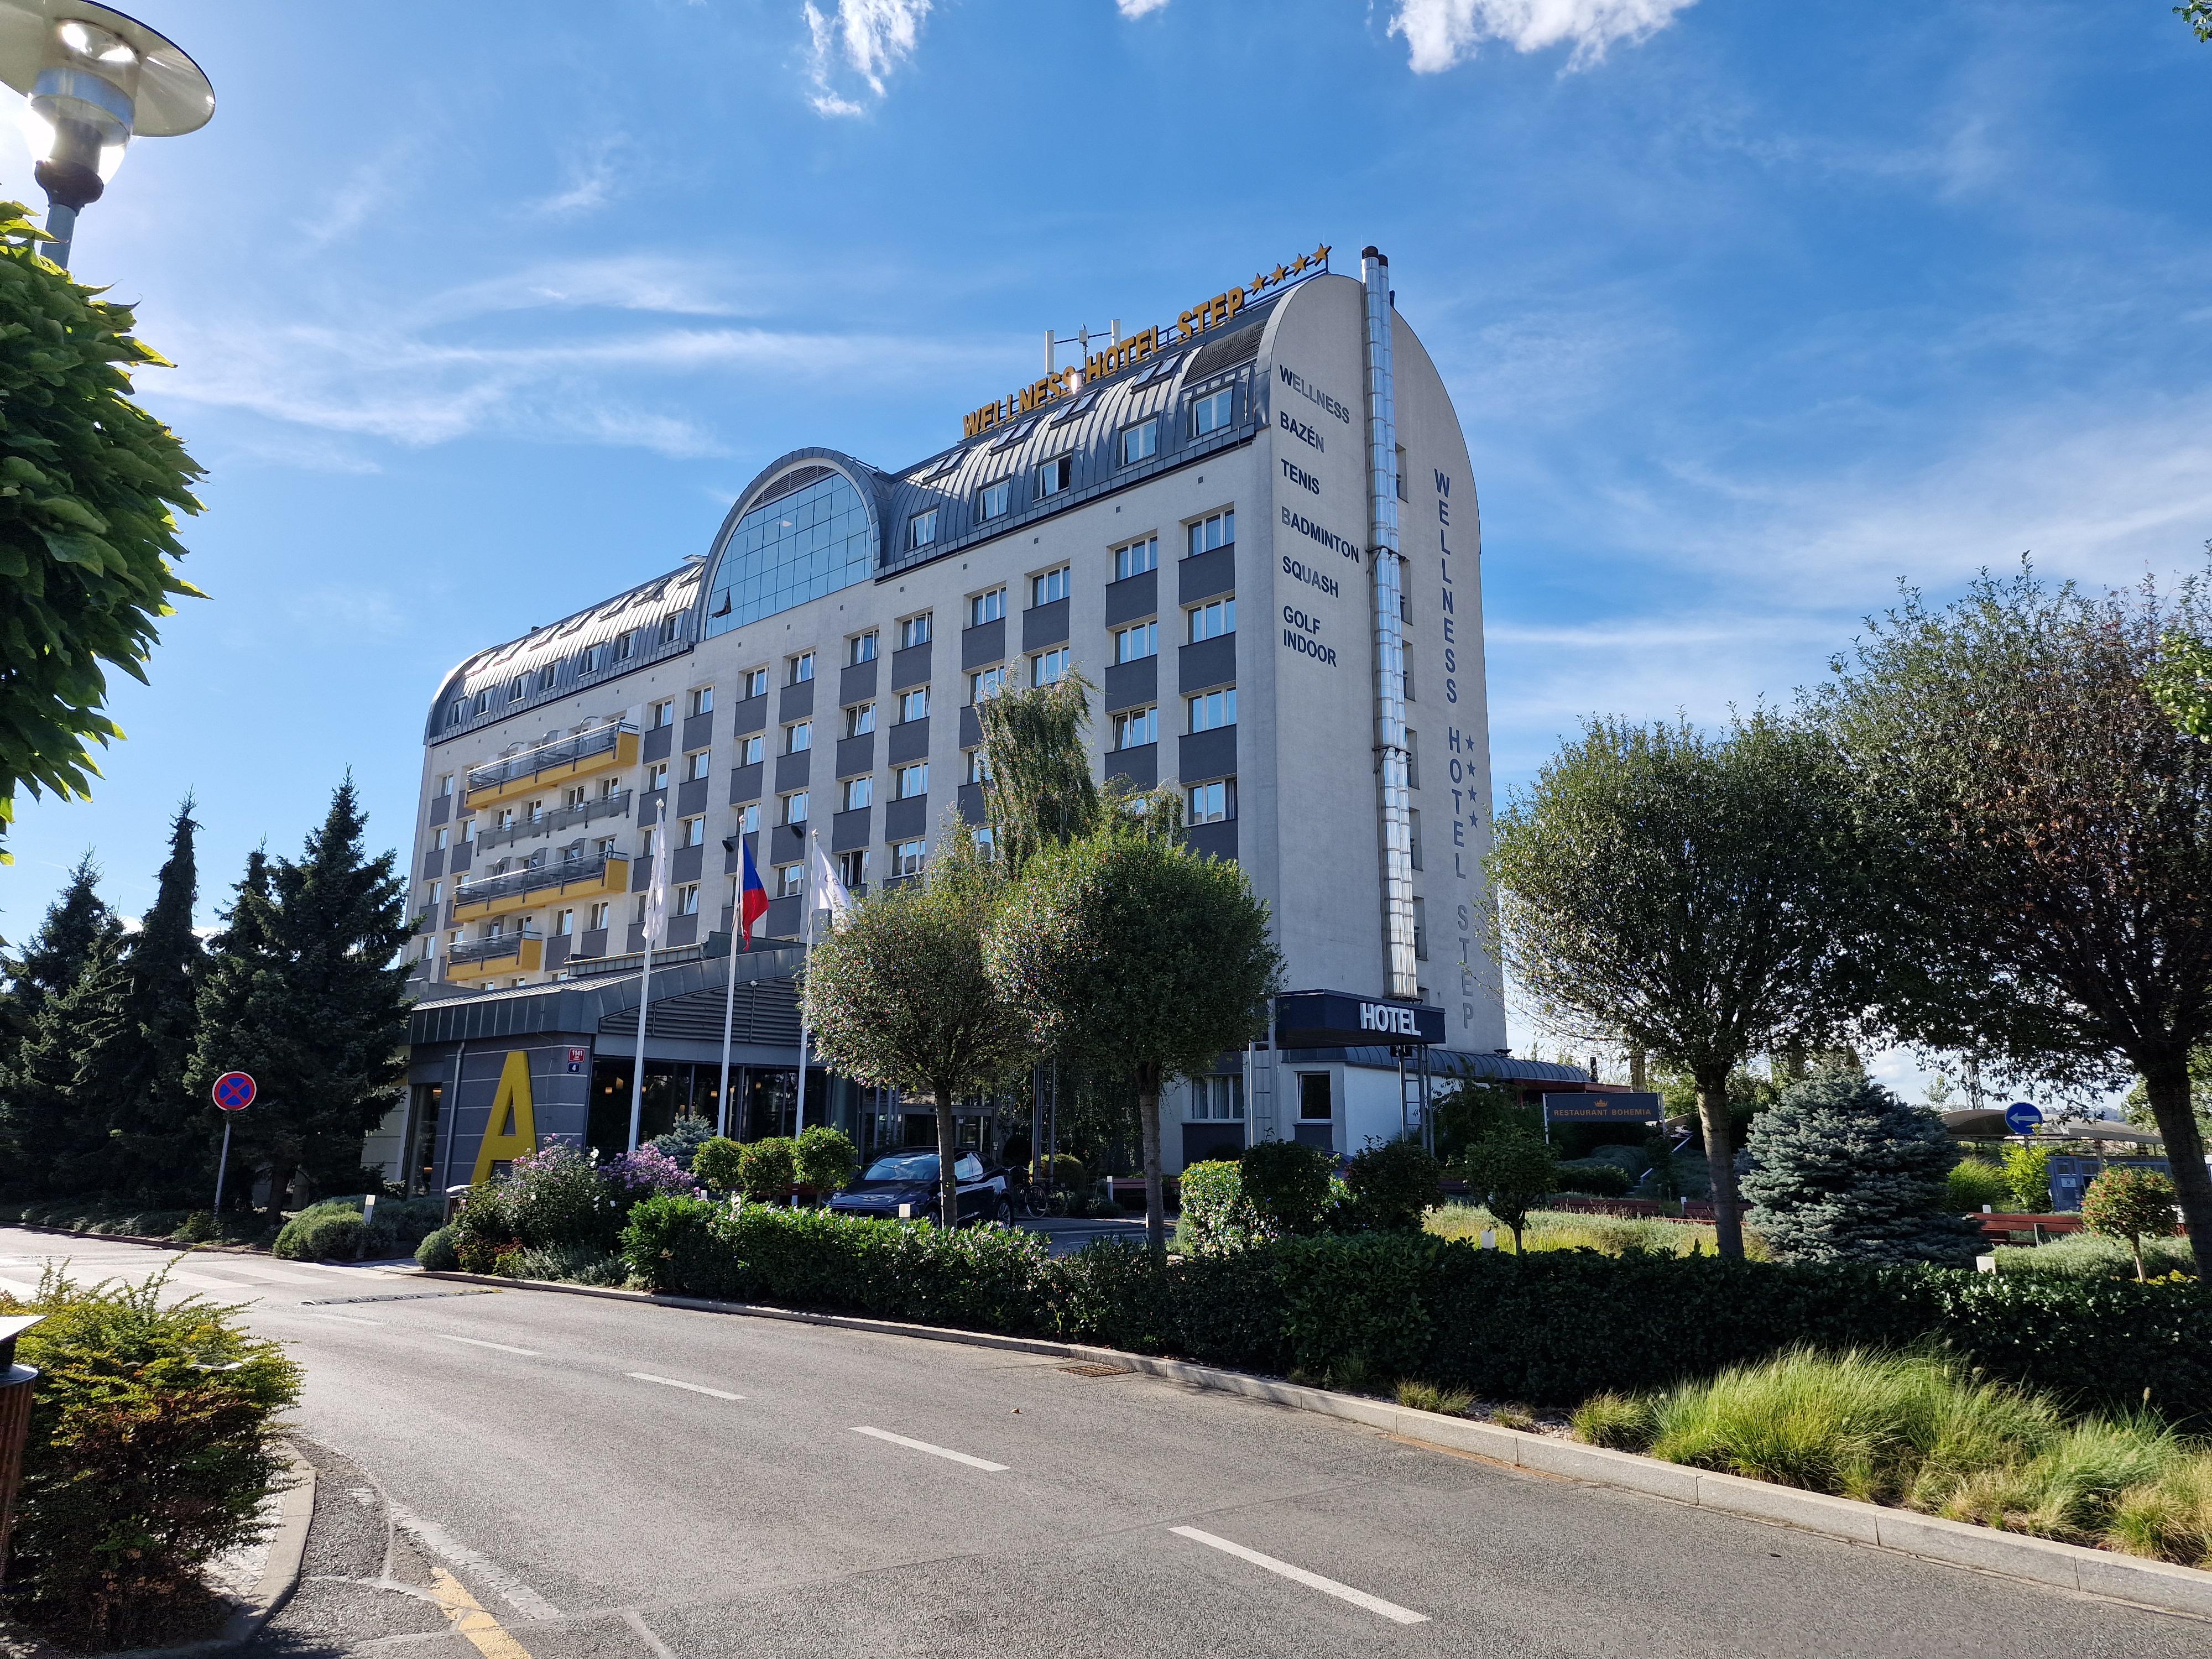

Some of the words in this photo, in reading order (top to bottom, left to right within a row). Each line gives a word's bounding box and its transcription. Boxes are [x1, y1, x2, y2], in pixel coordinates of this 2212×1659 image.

[963, 366, 1077, 438] WELLNESS
[1086, 325, 1160, 384] HOTEL
[1176, 286, 1244, 342] STEP
[1279, 364, 1350, 424] WELLNESS
[1280, 410, 1324, 453] BAZÉN
[1281, 458, 1320, 495] TENIS
[1281, 505, 1360, 564] BADMINTON
[1282, 555, 1339, 598] SQUASH
[1434, 468, 1457, 704] WELLNESS
[1283, 605, 1321, 635] GOLF
[1283, 629, 1337, 667] INDOOR
[1448, 726, 1467, 880] HOTEL
[1457, 904, 1474, 1029] STEP
[1359, 1003, 1422, 1036] HOTEL
[469, 1050, 538, 1186] A
